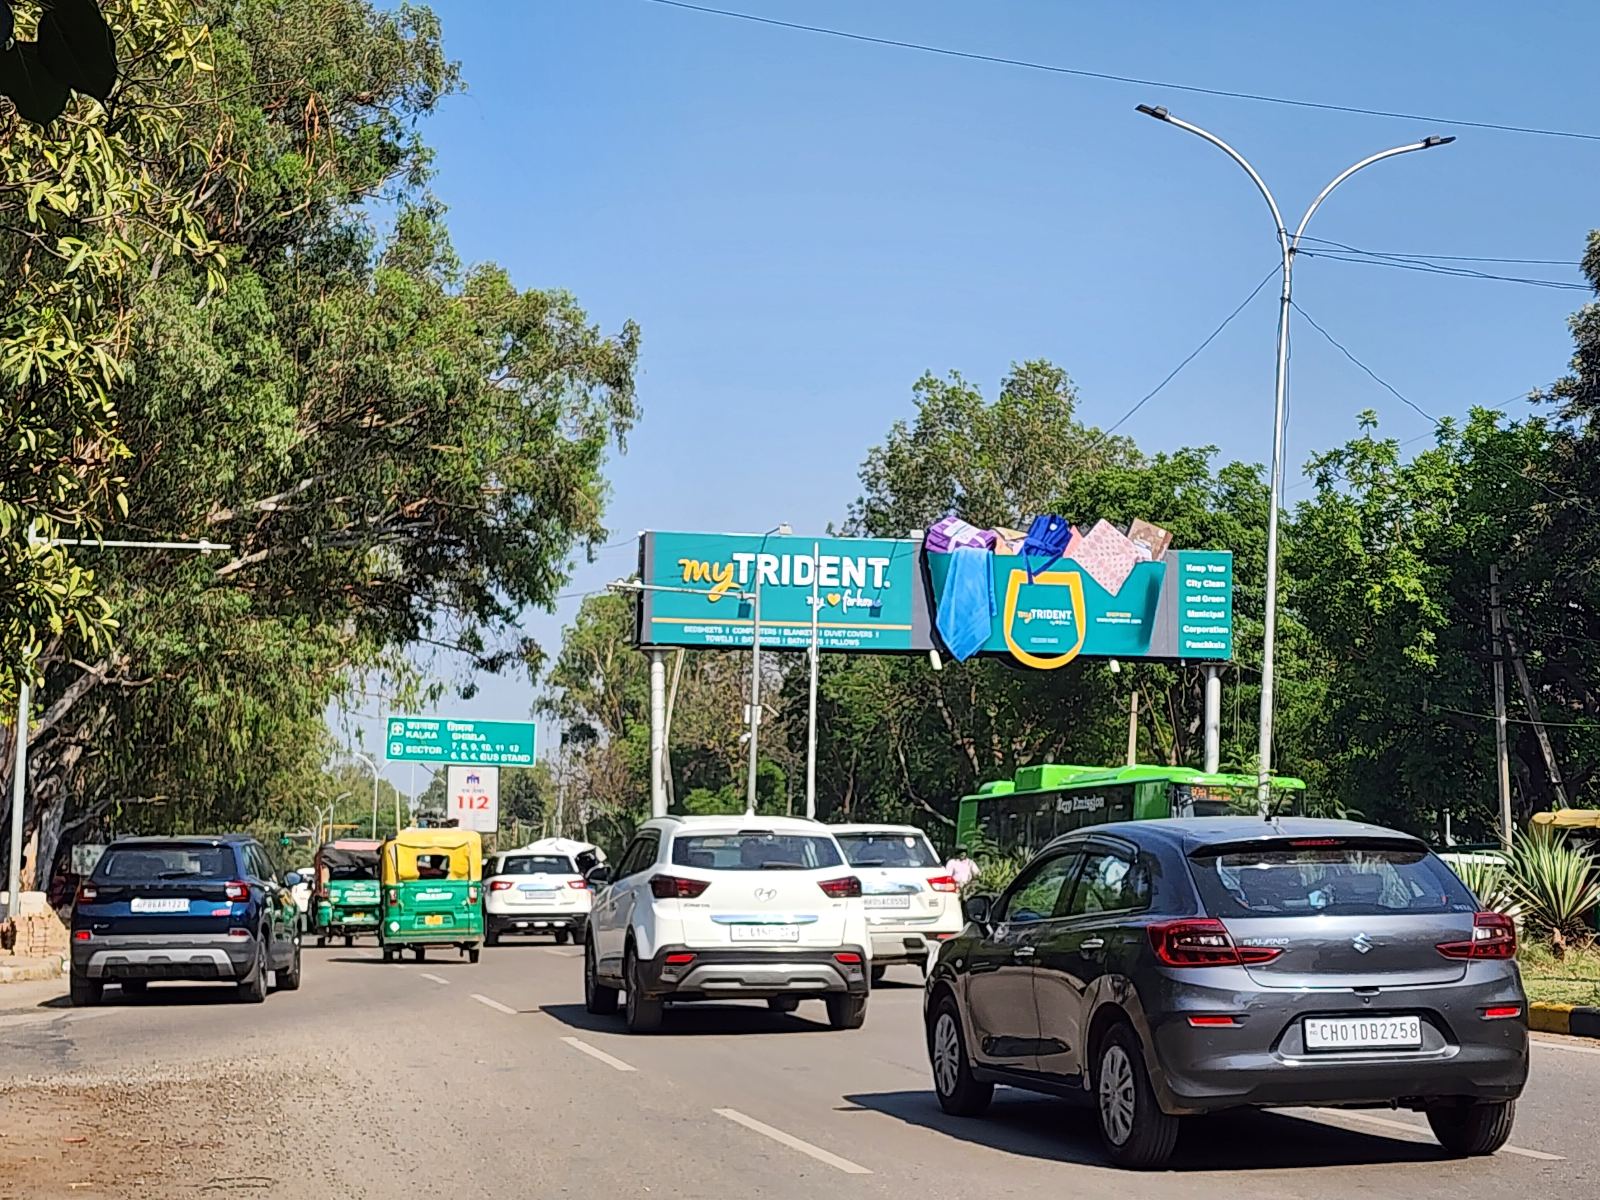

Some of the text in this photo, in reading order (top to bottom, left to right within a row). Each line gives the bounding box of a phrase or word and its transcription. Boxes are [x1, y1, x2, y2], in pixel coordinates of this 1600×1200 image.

[1186, 564, 1226, 573] Keep Your
[1186, 579, 1226, 589] City Clean
[1186, 595, 1226, 603] and Green
[1186, 609, 1225, 619] Municipal
[1182, 625, 1229, 635] Corporation
[405, 746, 442, 754] SECTOR
[501, 753, 531, 762] STAND
[458, 795, 489, 809] 112
[1320, 1022, 1418, 1041] CH01DB2258
